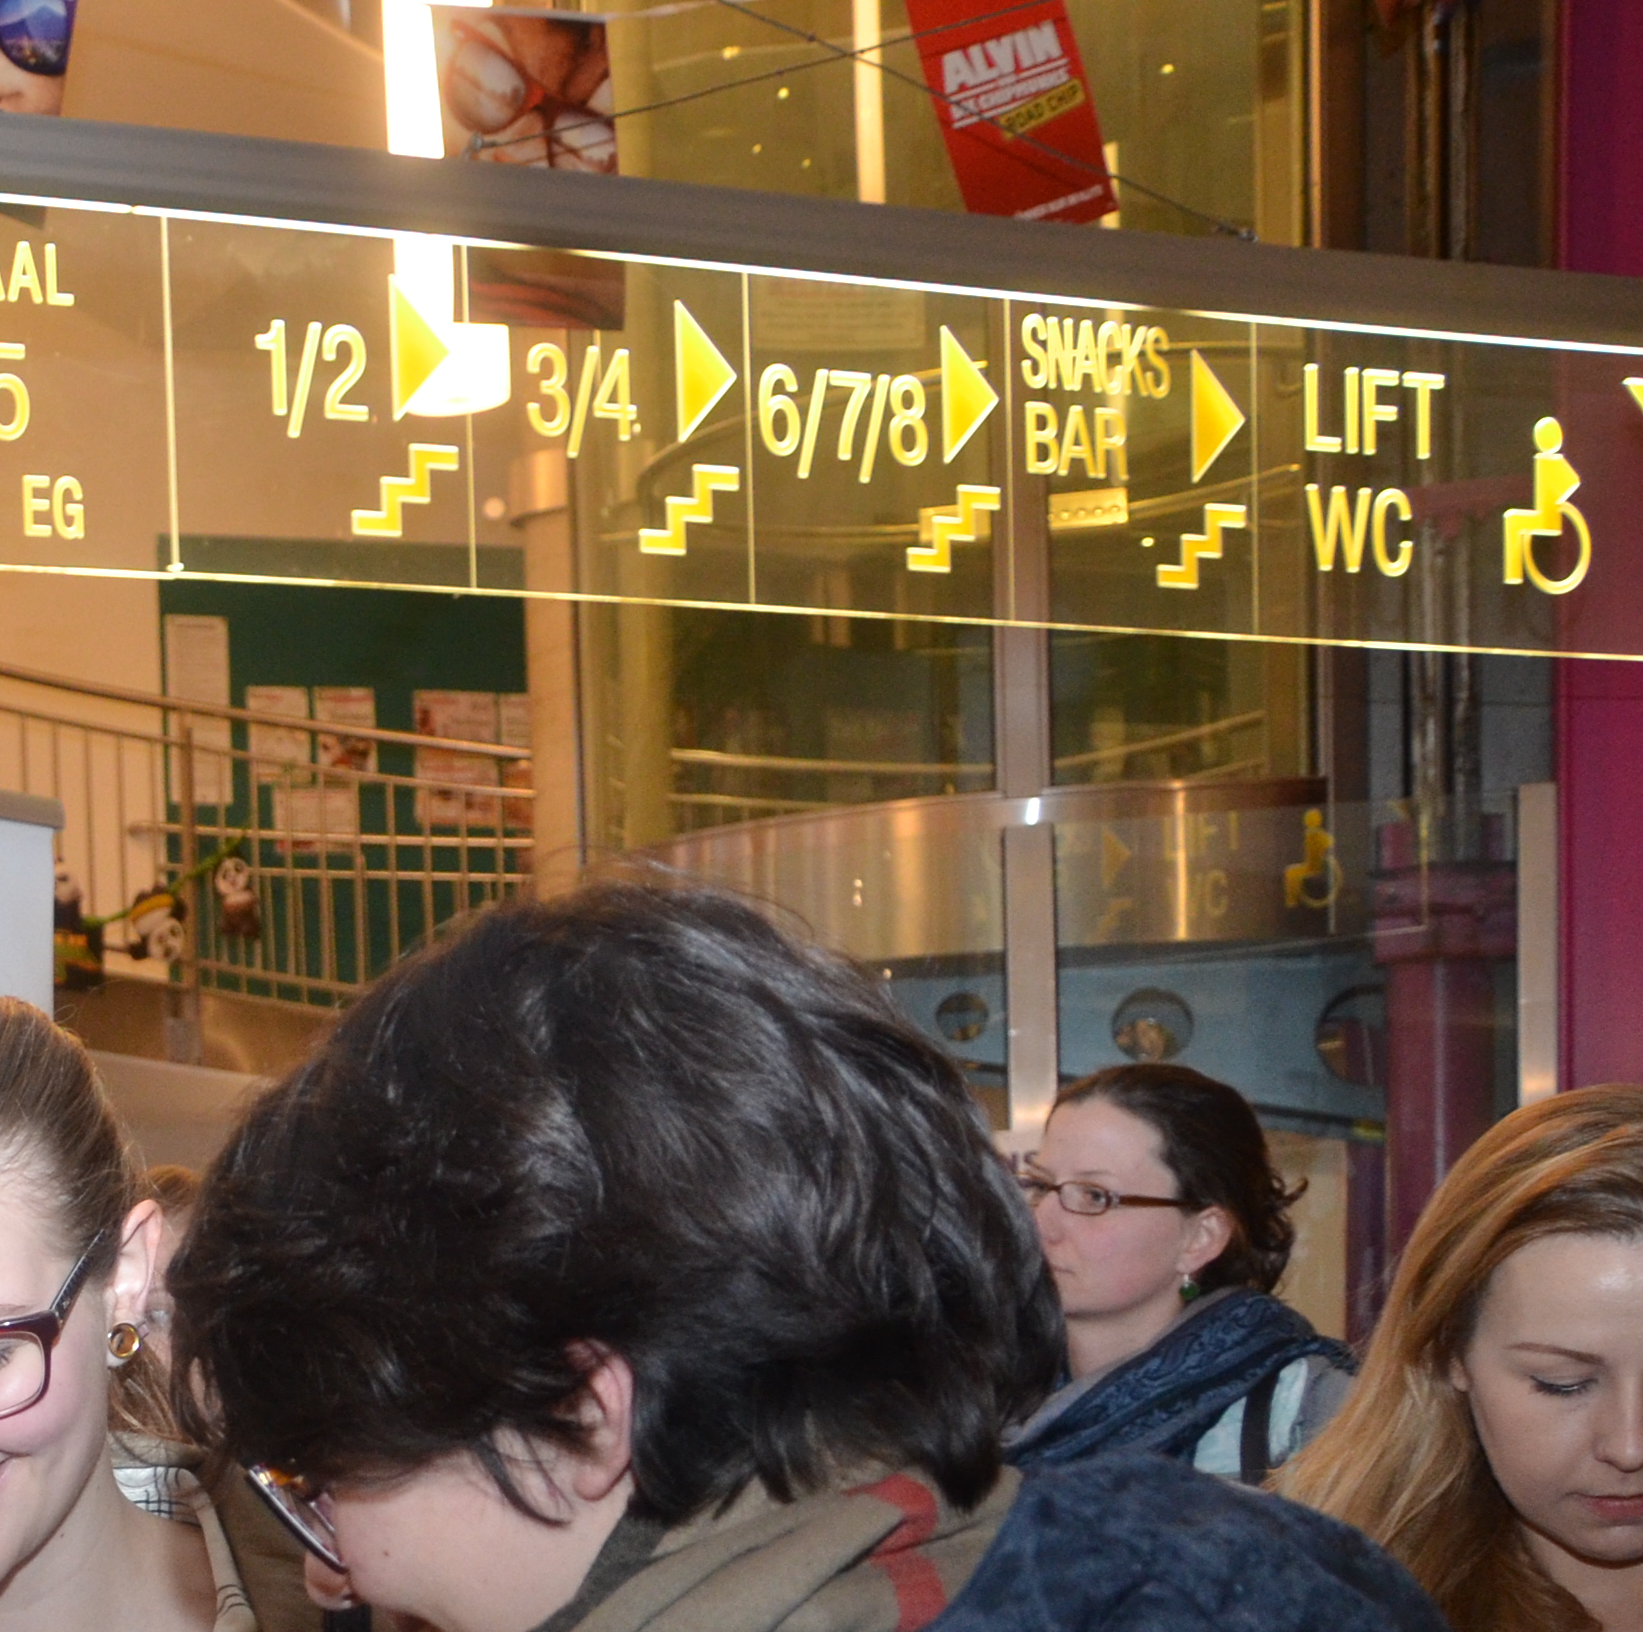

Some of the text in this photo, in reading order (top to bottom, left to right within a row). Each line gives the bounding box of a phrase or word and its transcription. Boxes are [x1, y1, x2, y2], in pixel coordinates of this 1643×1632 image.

[941, 19, 1064, 94] ALVIN
[254, 318, 370, 438] 1/2
[526, 342, 637, 458] 3/4
[1021, 312, 1172, 399] SNACKS
[758, 362, 930, 484] 6/7/8
[1024, 400, 1130, 481] BAR
[1304, 363, 1446, 459] LIFT
[21, 473, 86, 541] EG
[1305, 483, 1413, 577] WC
